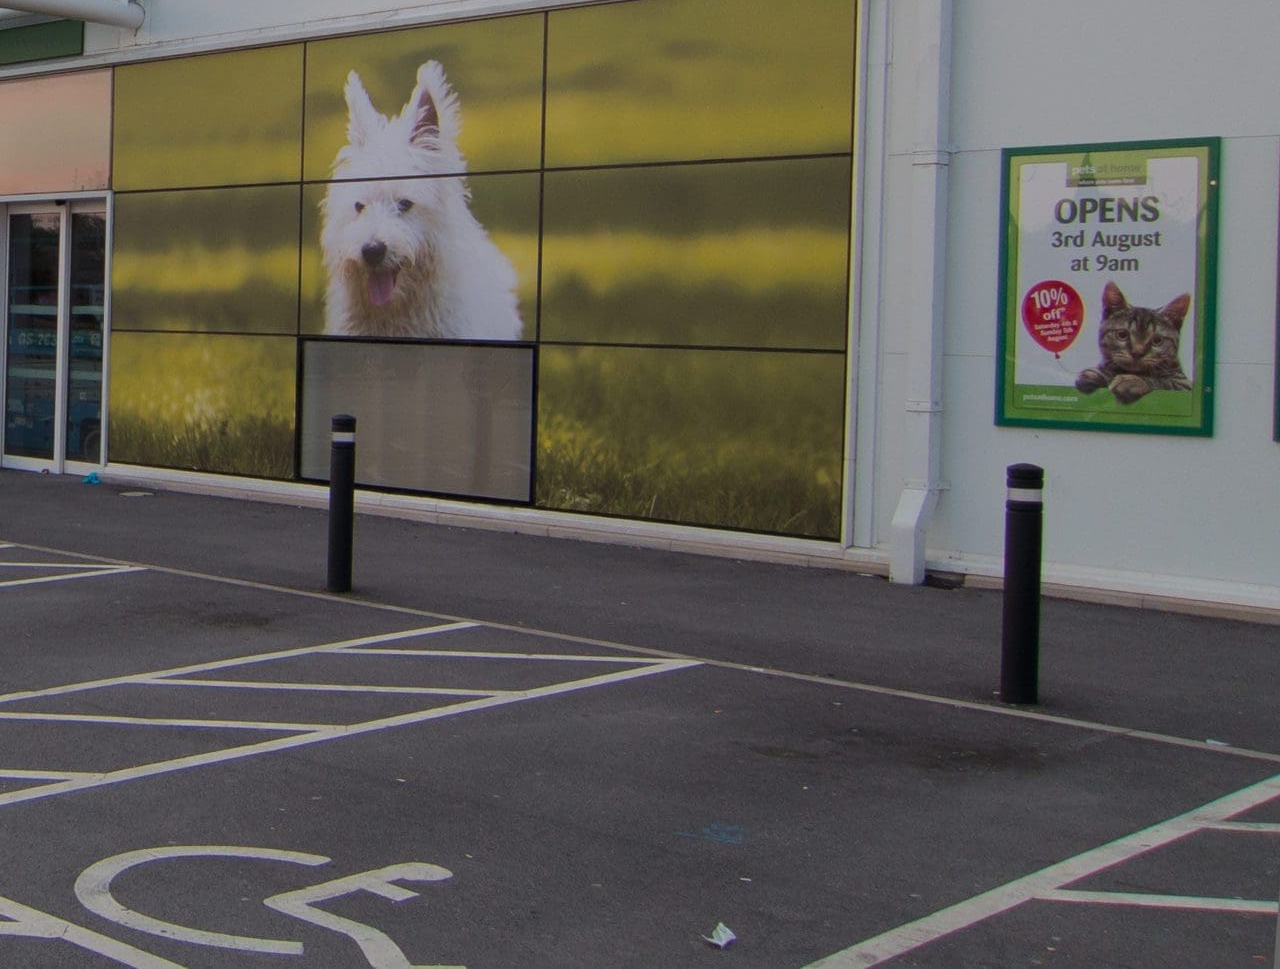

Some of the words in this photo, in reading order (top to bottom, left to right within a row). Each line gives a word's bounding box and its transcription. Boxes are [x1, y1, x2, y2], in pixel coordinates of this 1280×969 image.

[1054, 196, 1160, 225] OPENS
[1051, 230, 1085, 248] 3rd
[1091, 231, 1162, 252] August
[1071, 256, 1090, 271] at
[1096, 254, 1139, 272] 9am
[1030, 287, 1068, 309] 10%
